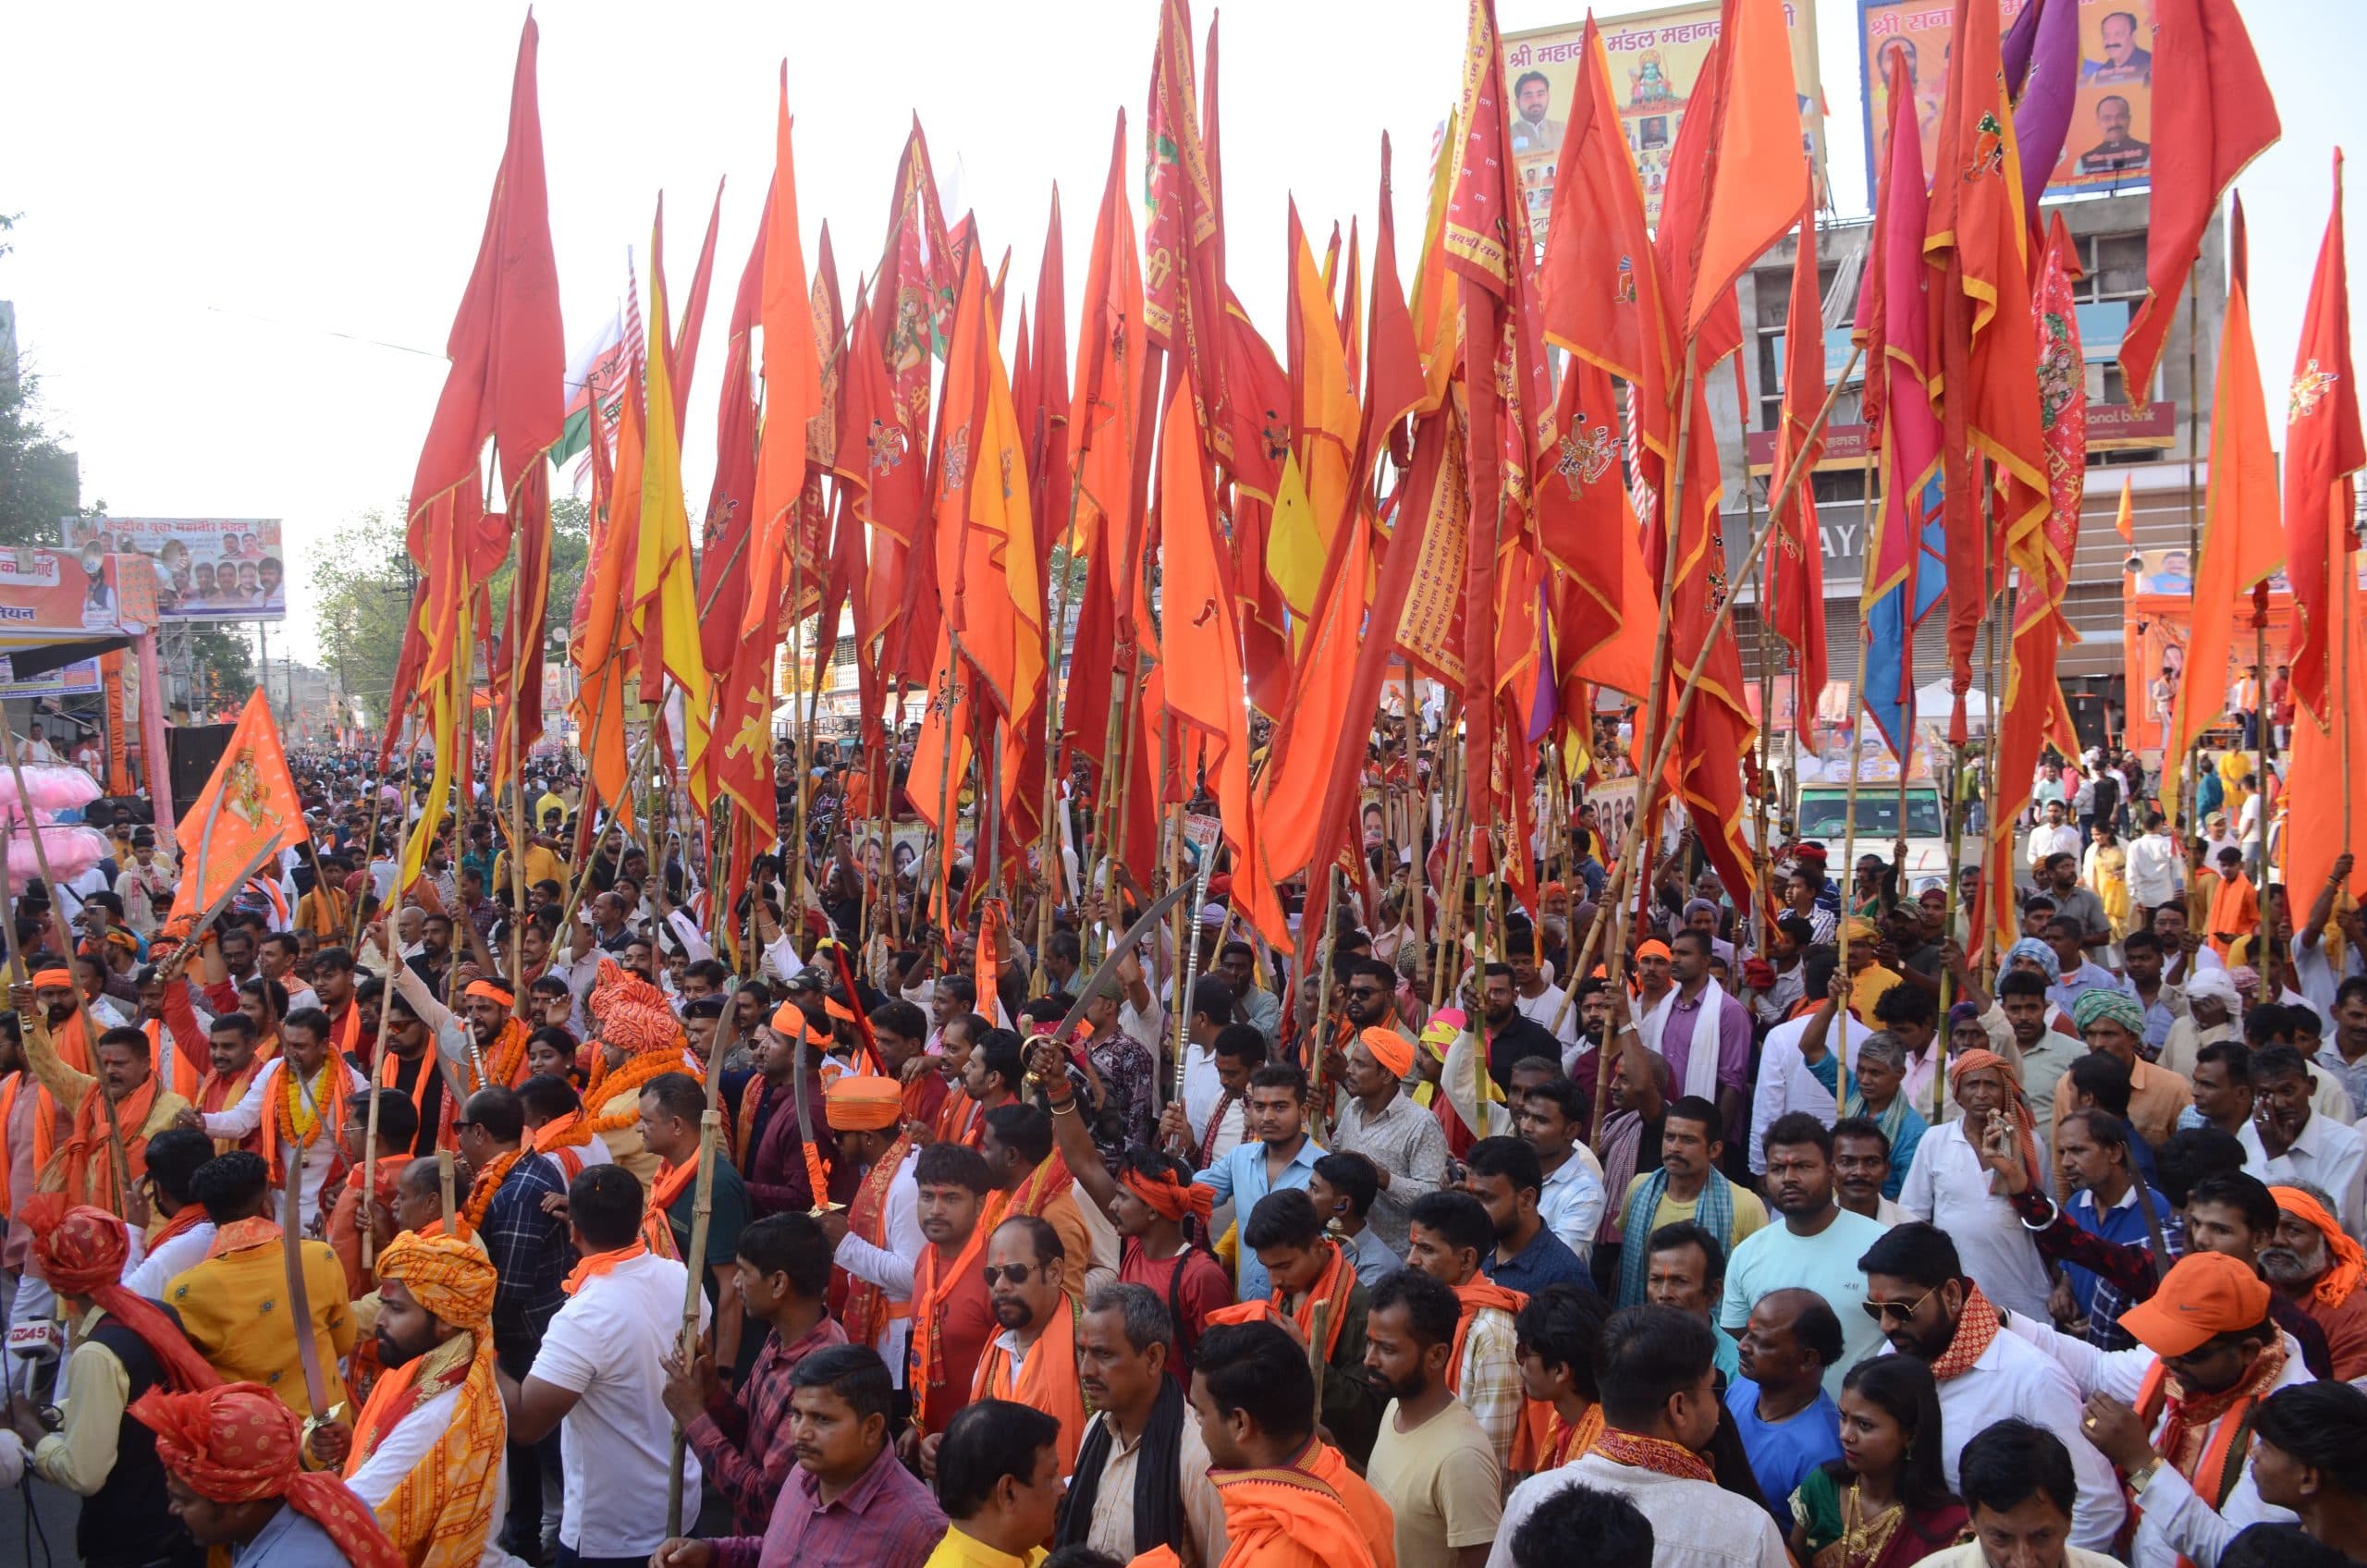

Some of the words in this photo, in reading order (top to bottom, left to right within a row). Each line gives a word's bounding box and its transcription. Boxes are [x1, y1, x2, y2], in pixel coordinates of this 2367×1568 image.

[1870, 14, 1902, 35] श्री
[1509, 43, 1533, 67] श्री
[1538, 33, 1584, 65] महाव
[1607, 29, 1656, 53] मंडल
